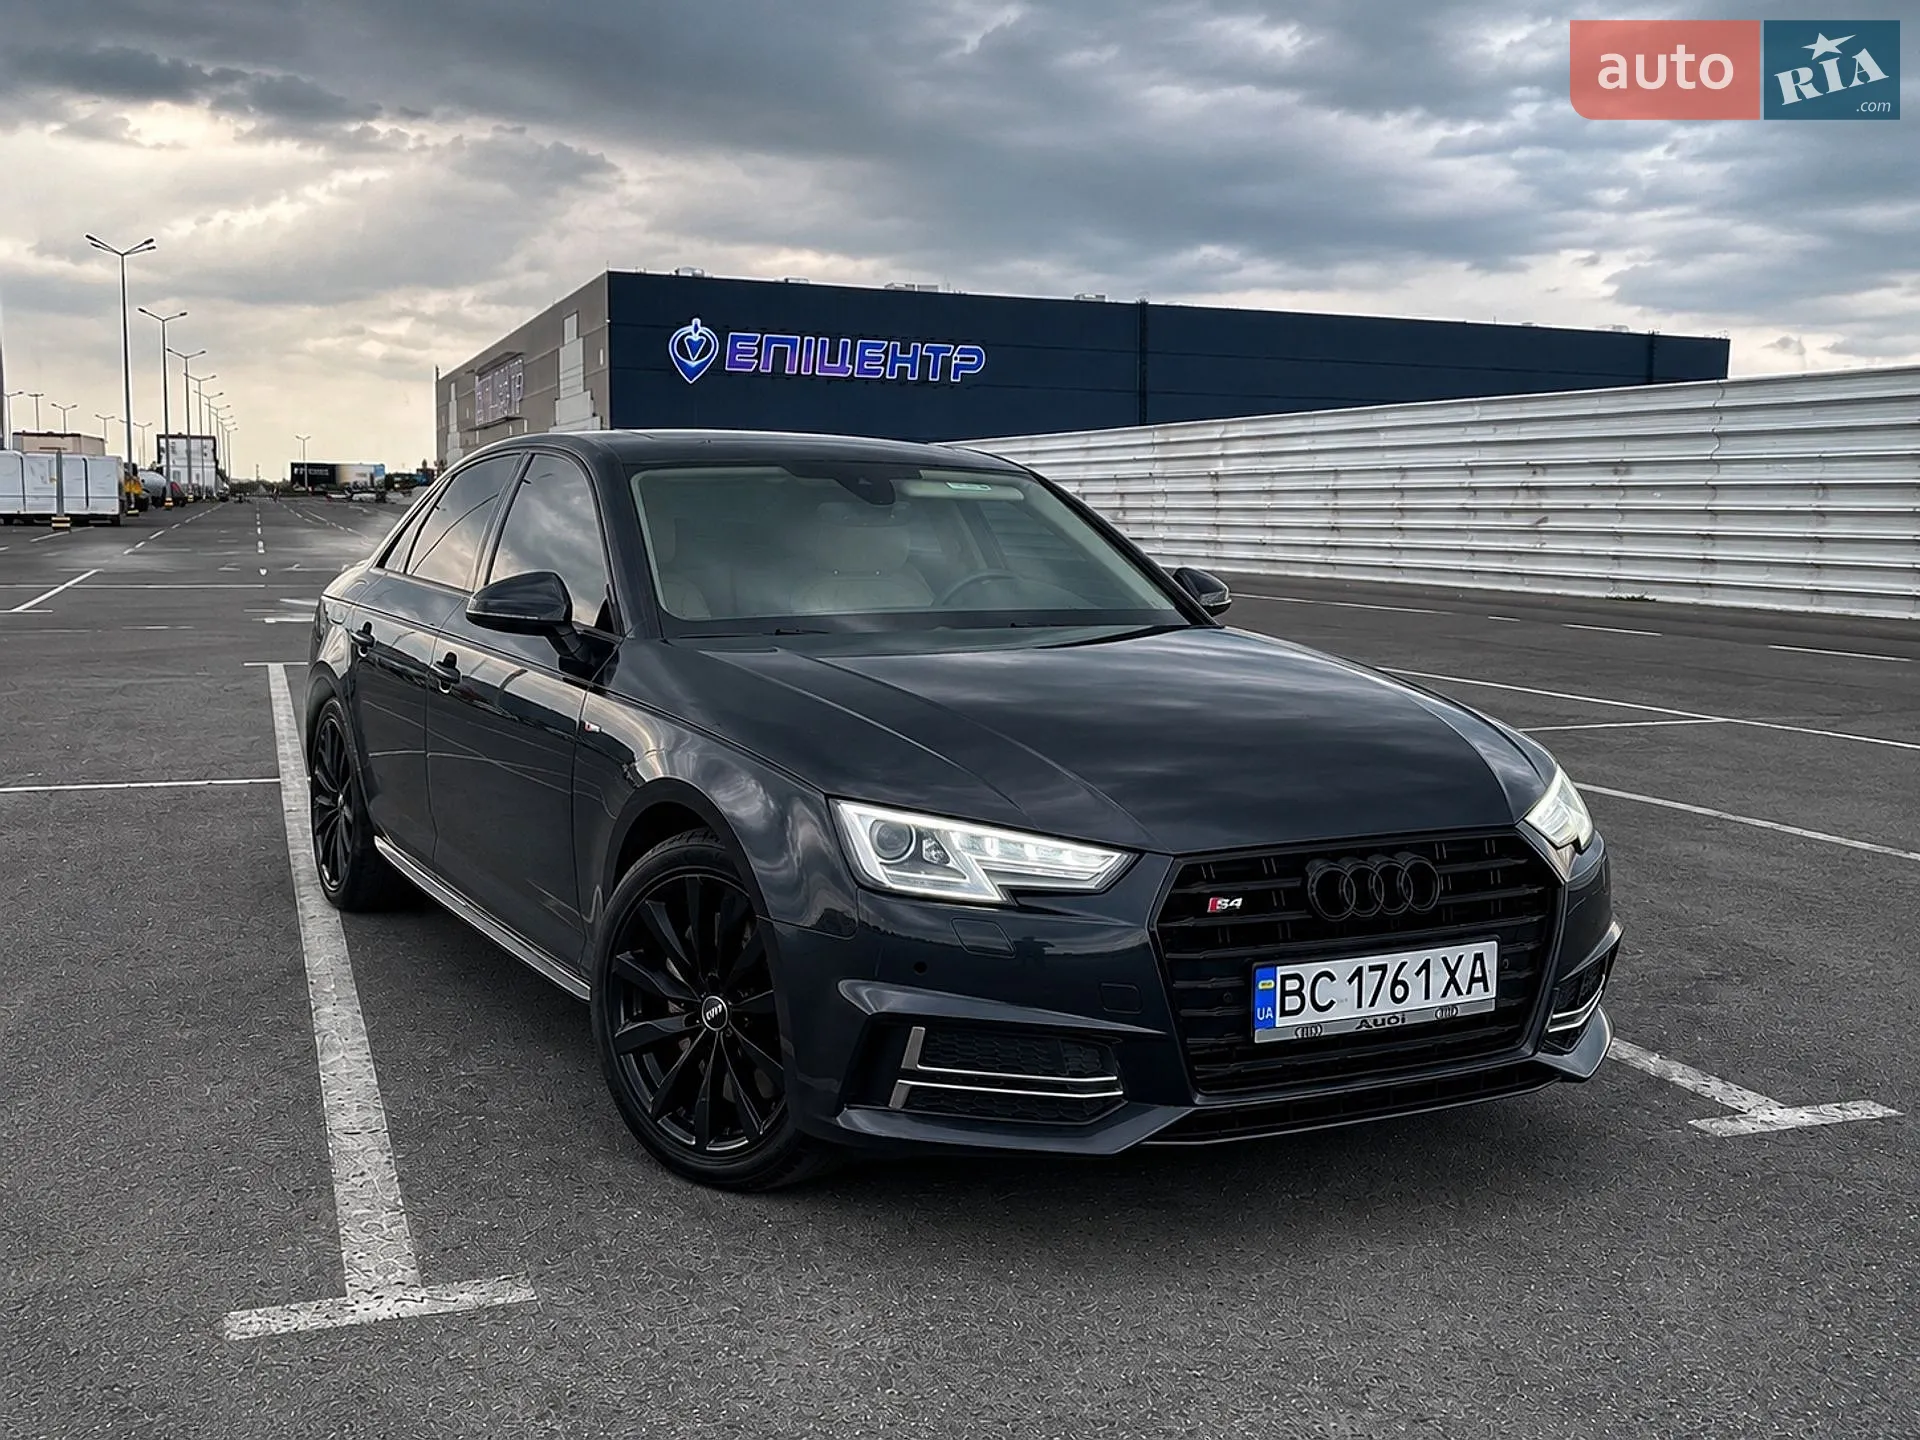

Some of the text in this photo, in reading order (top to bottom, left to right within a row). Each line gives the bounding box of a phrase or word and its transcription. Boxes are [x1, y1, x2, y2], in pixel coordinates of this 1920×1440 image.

[725, 332, 986, 383] ЕПІЦЕНТР
[1215, 896, 1243, 912] S4
[1256, 1006, 1274, 1021] UA
[1357, 1014, 1407, 1030] Audi
